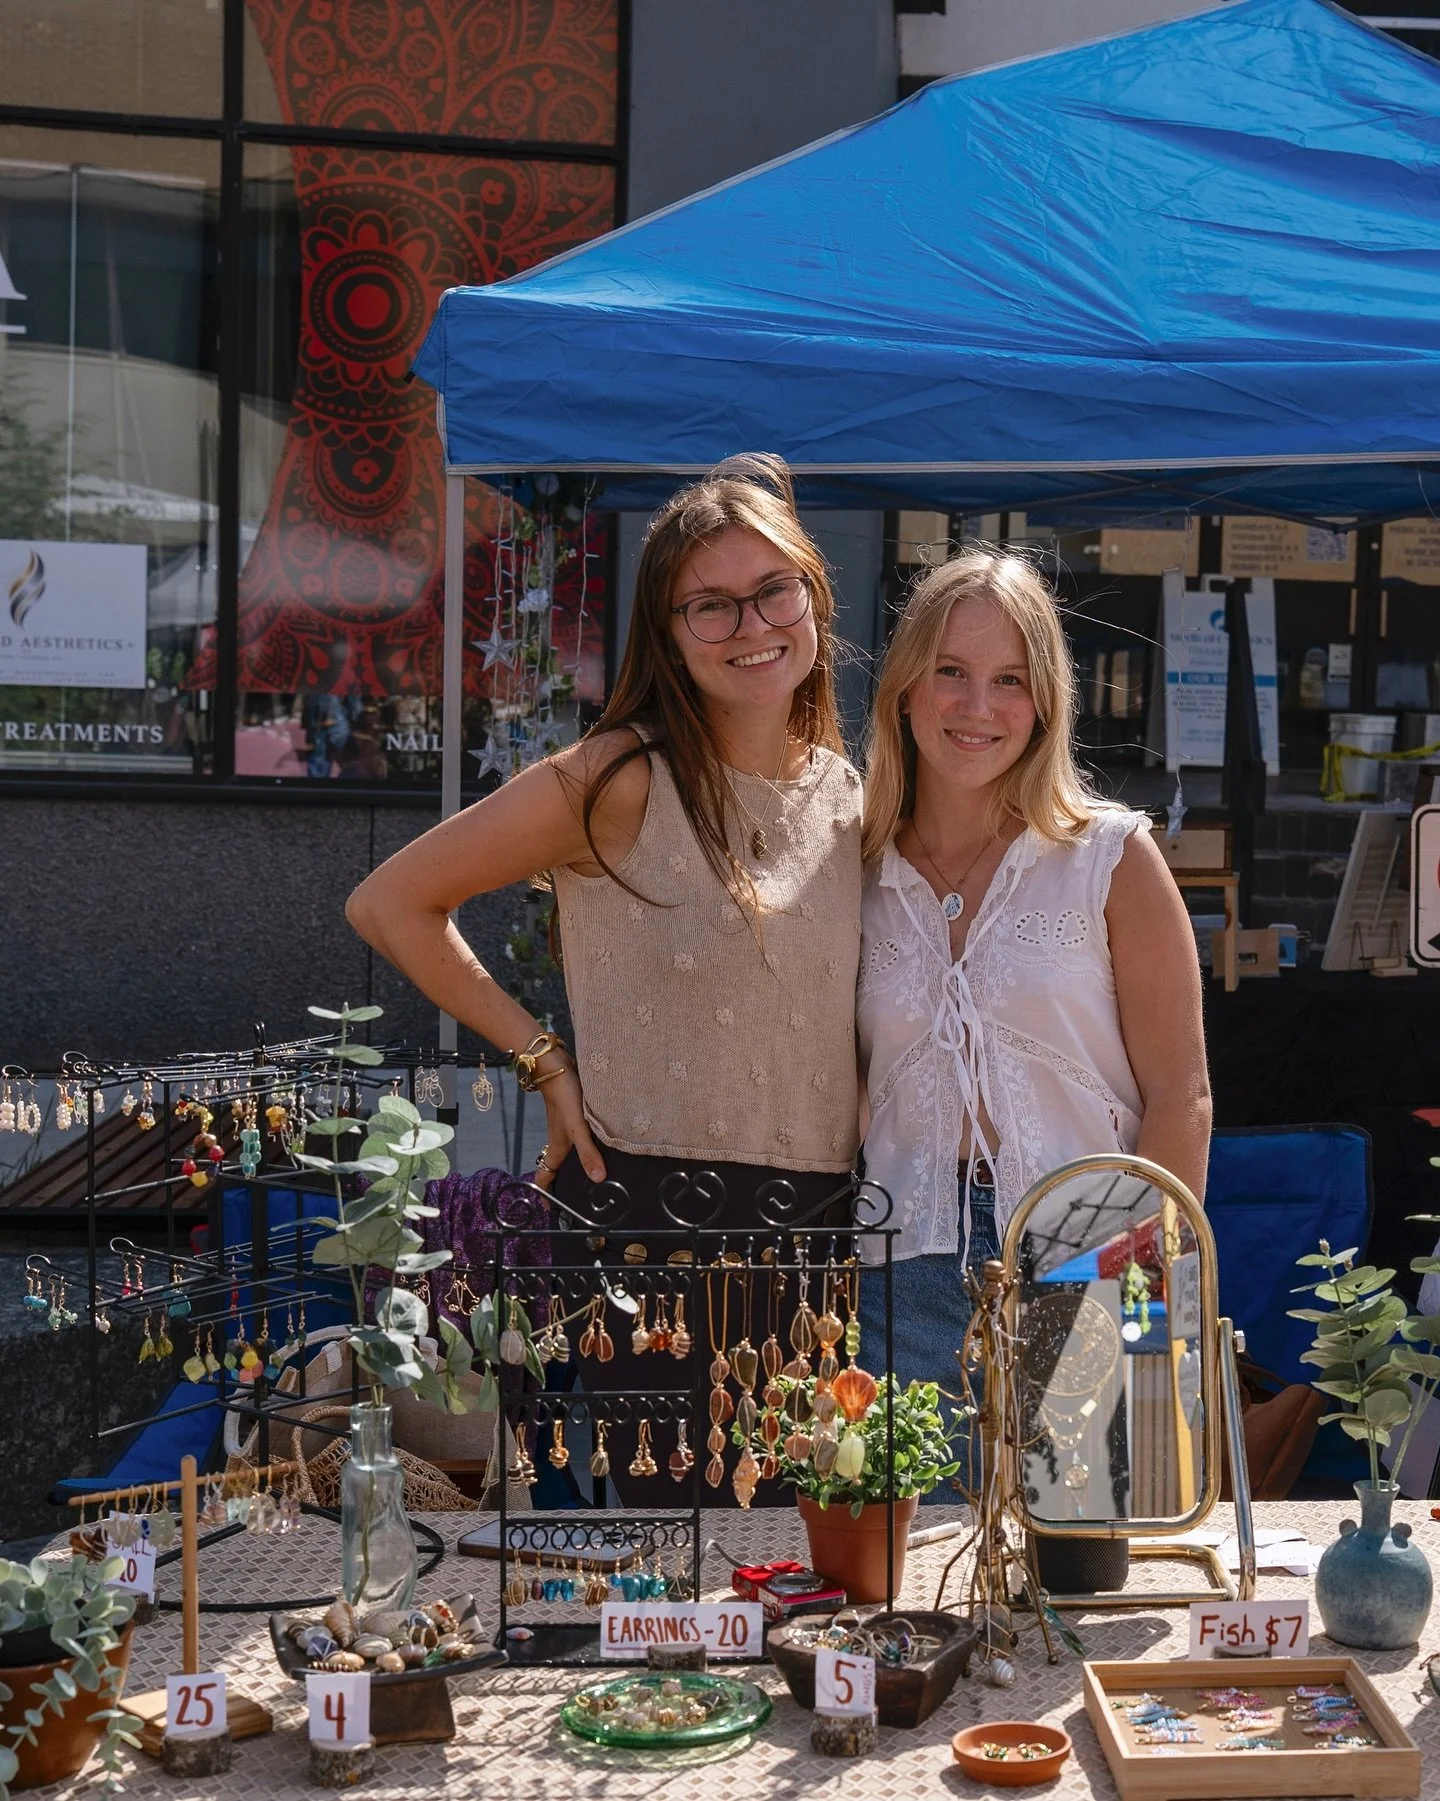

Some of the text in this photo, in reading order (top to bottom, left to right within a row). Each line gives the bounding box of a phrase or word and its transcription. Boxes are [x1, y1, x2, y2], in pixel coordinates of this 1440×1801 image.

[20, 635, 124, 650] AESTHETICS
[0, 721, 164, 744] REATMENTS
[1199, 1613, 1302, 1648] Fish $7
[834, 1659, 857, 1705] 5
[175, 1682, 217, 1727] 25
[324, 1692, 346, 1740] 4
